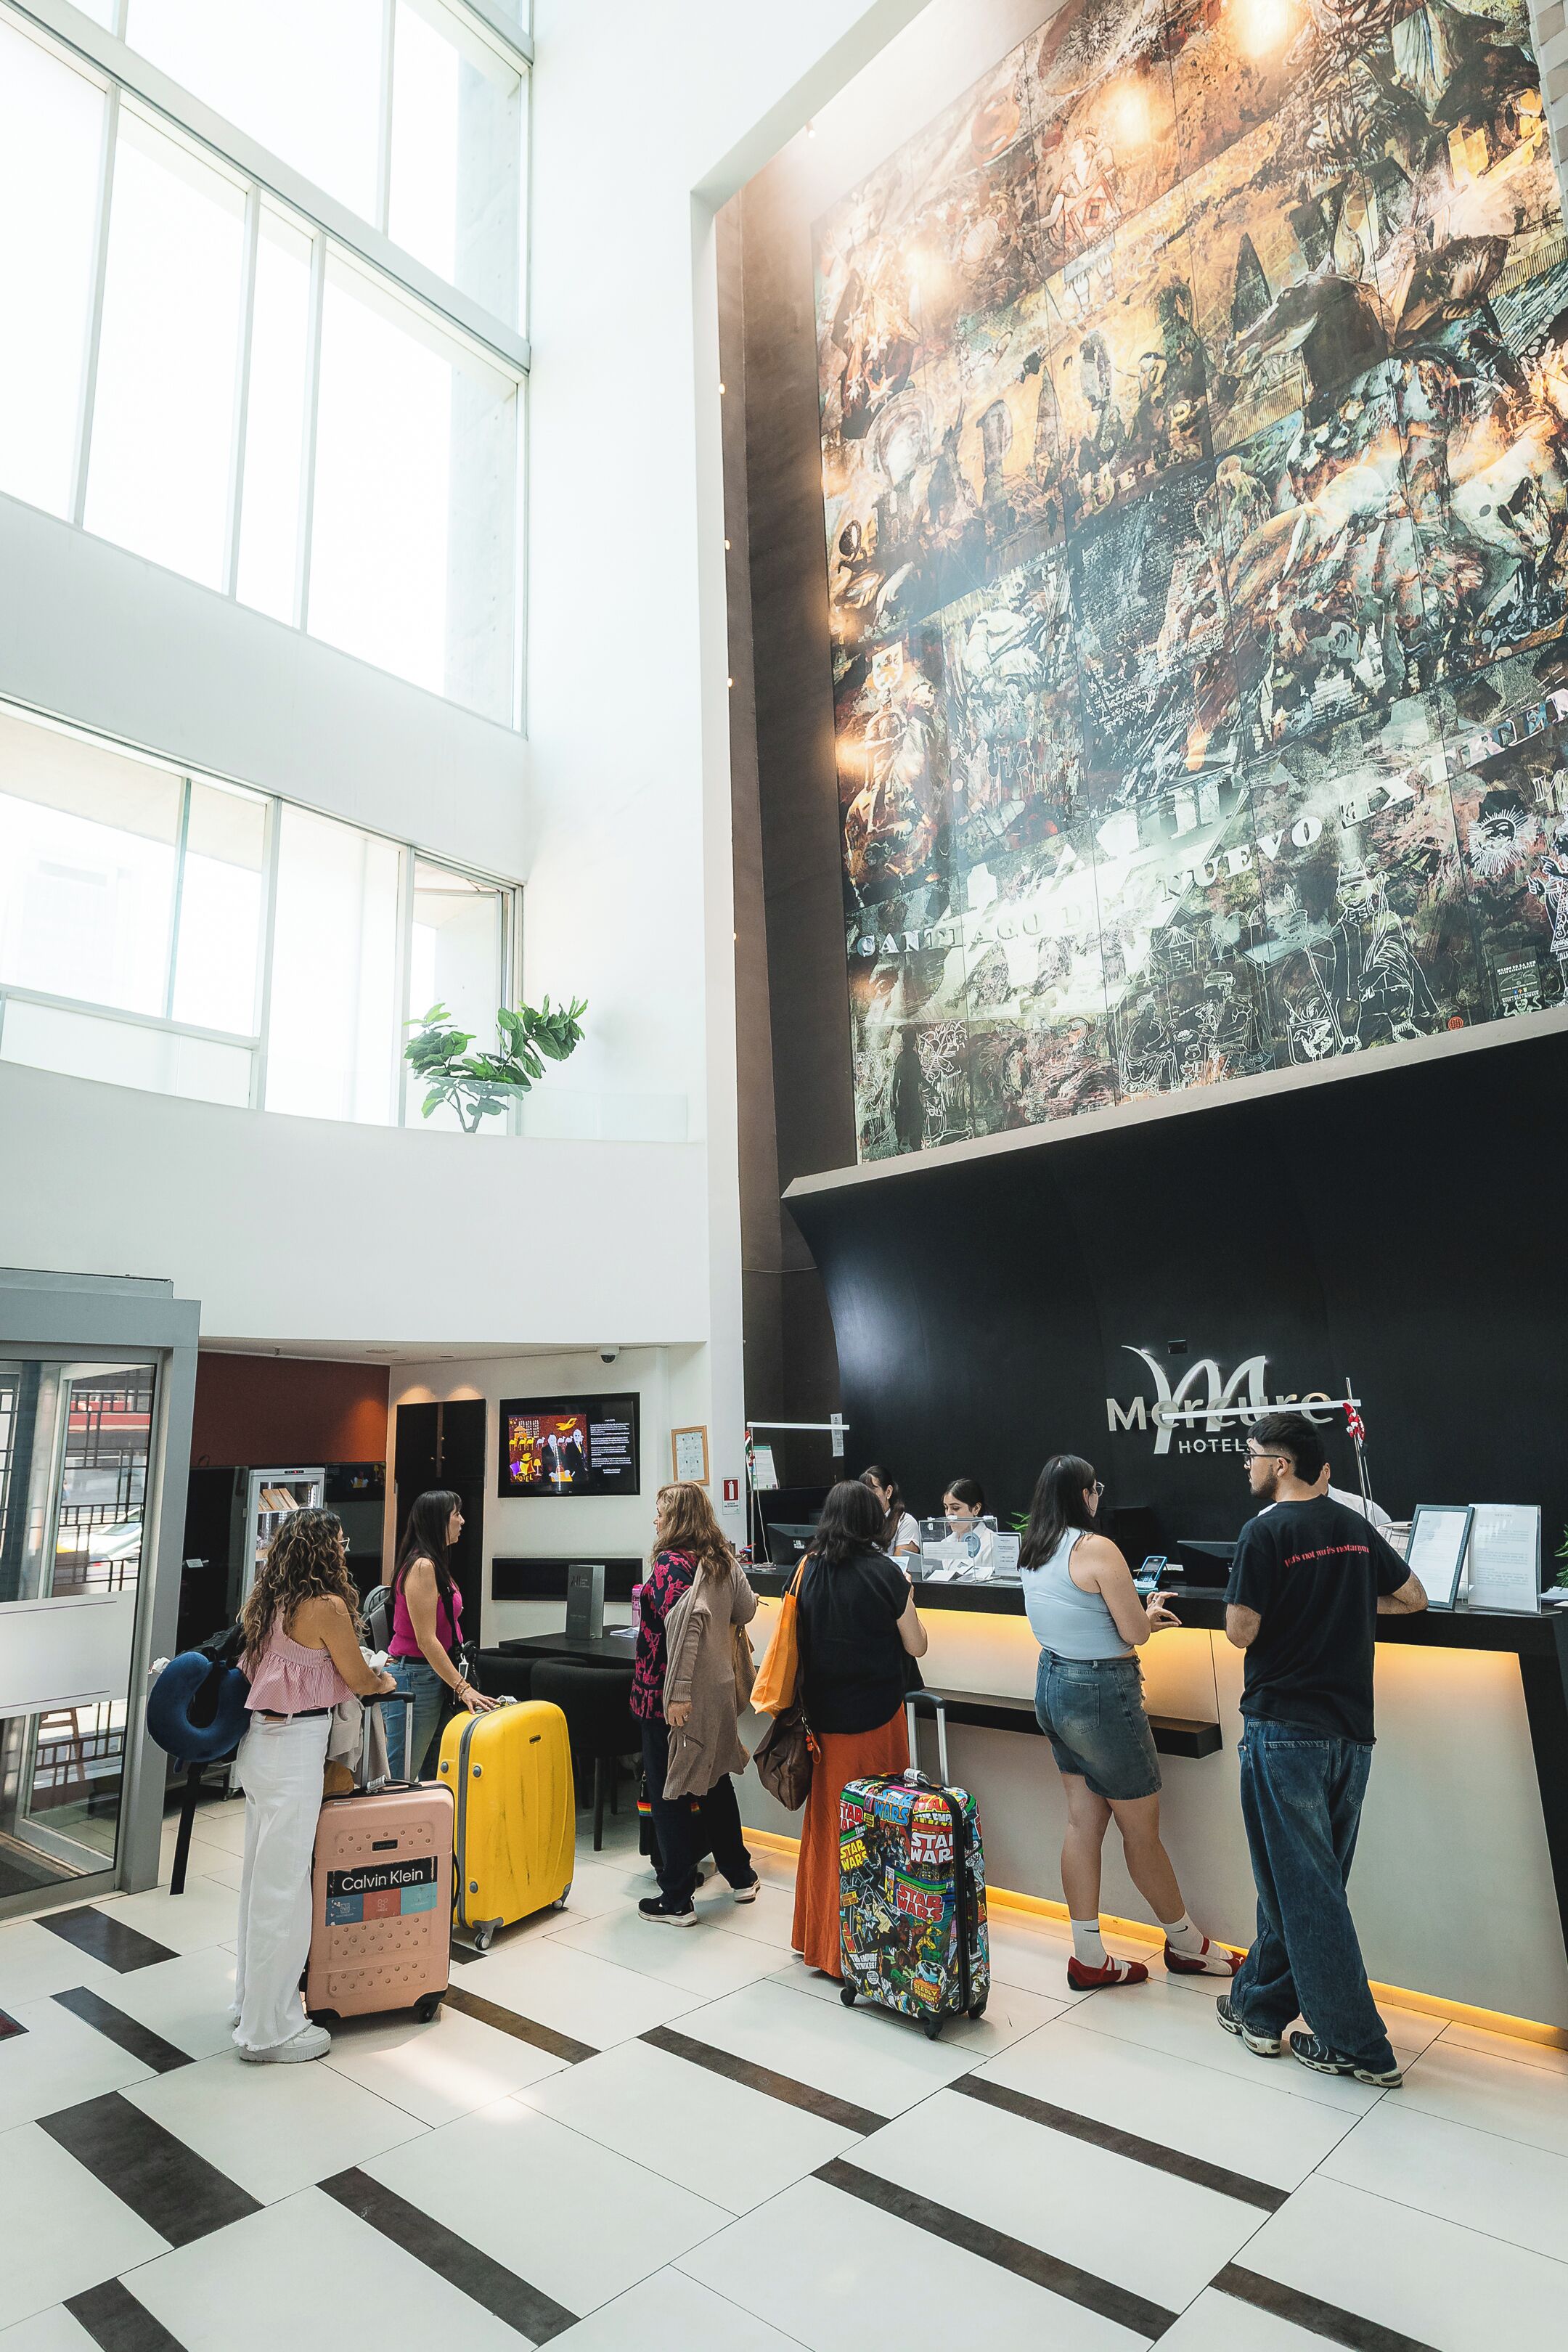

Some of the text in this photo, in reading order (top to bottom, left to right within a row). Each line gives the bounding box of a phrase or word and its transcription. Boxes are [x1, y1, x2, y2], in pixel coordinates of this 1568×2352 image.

[1161, 817, 1323, 902] NUEVO
[874, 1800, 910, 1825] WARS
[841, 1839, 865, 1859] STAR
[841, 1850, 868, 1871] WARS
[342, 1869, 423, 1891] Calvin Klein
[897, 1884, 943, 1908] STAR
[897, 1895, 944, 1922] WARS
[914, 1983, 937, 1996] DEADLY
